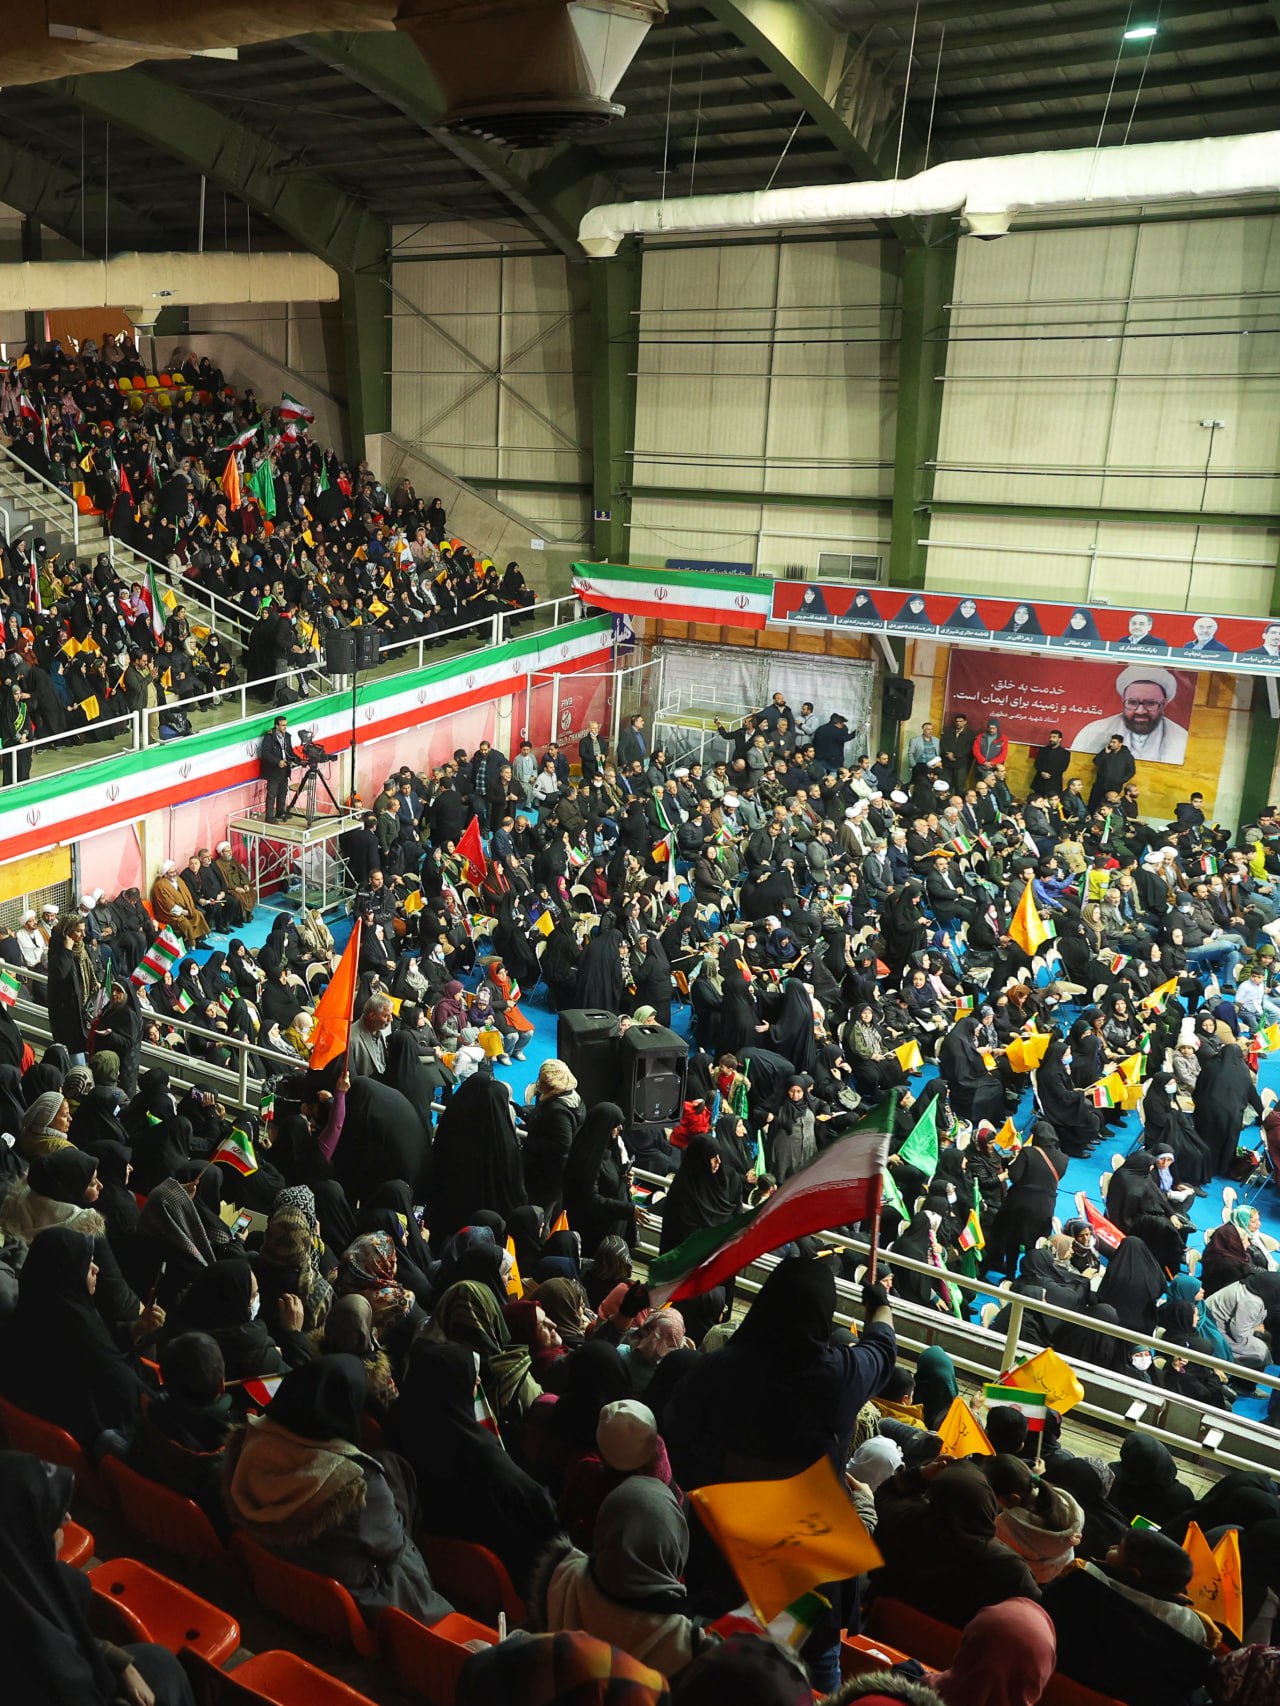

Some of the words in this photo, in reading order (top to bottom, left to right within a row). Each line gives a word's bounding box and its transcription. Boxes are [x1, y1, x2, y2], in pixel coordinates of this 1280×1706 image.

[1017, 683, 1028, 693] به
[1030, 685, 1066, 695] خدمت
[953, 690, 980, 701] است.
[981, 692, 1009, 706] ایمان
[1009, 696, 1030, 709] برای
[1030, 699, 1059, 713] زمینه
[1060, 704, 1067, 714] و
[1068, 704, 1104, 716] مقدمه
[1027, 715, 1043, 723] شهید
